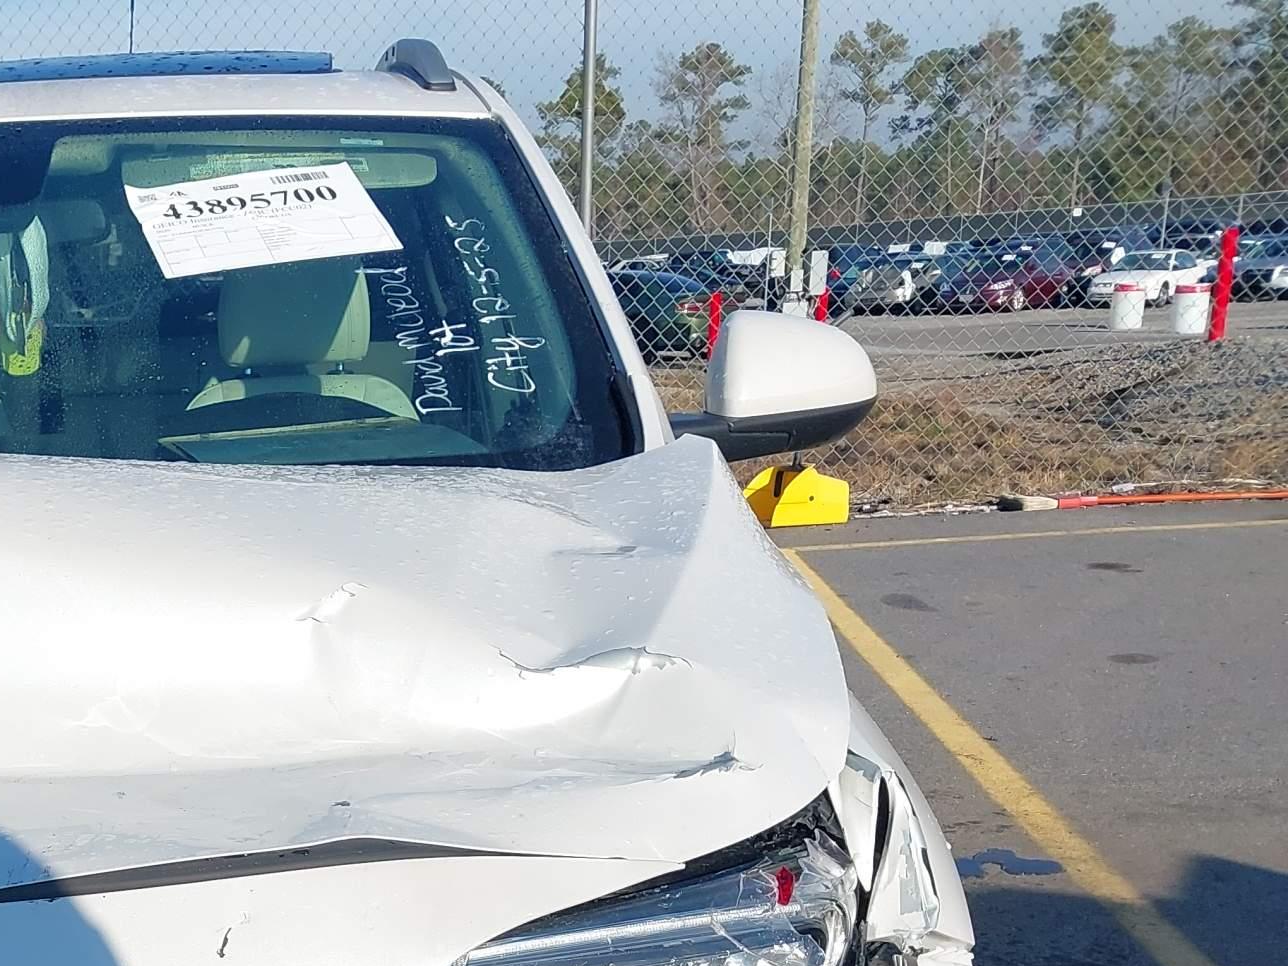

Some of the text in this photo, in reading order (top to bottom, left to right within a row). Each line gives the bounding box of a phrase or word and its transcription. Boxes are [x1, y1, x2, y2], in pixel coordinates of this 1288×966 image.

[162, 185, 338, 219] 43895700
[443, 215, 546, 393] City 12-5-25
[402, 357, 464, 415] David
